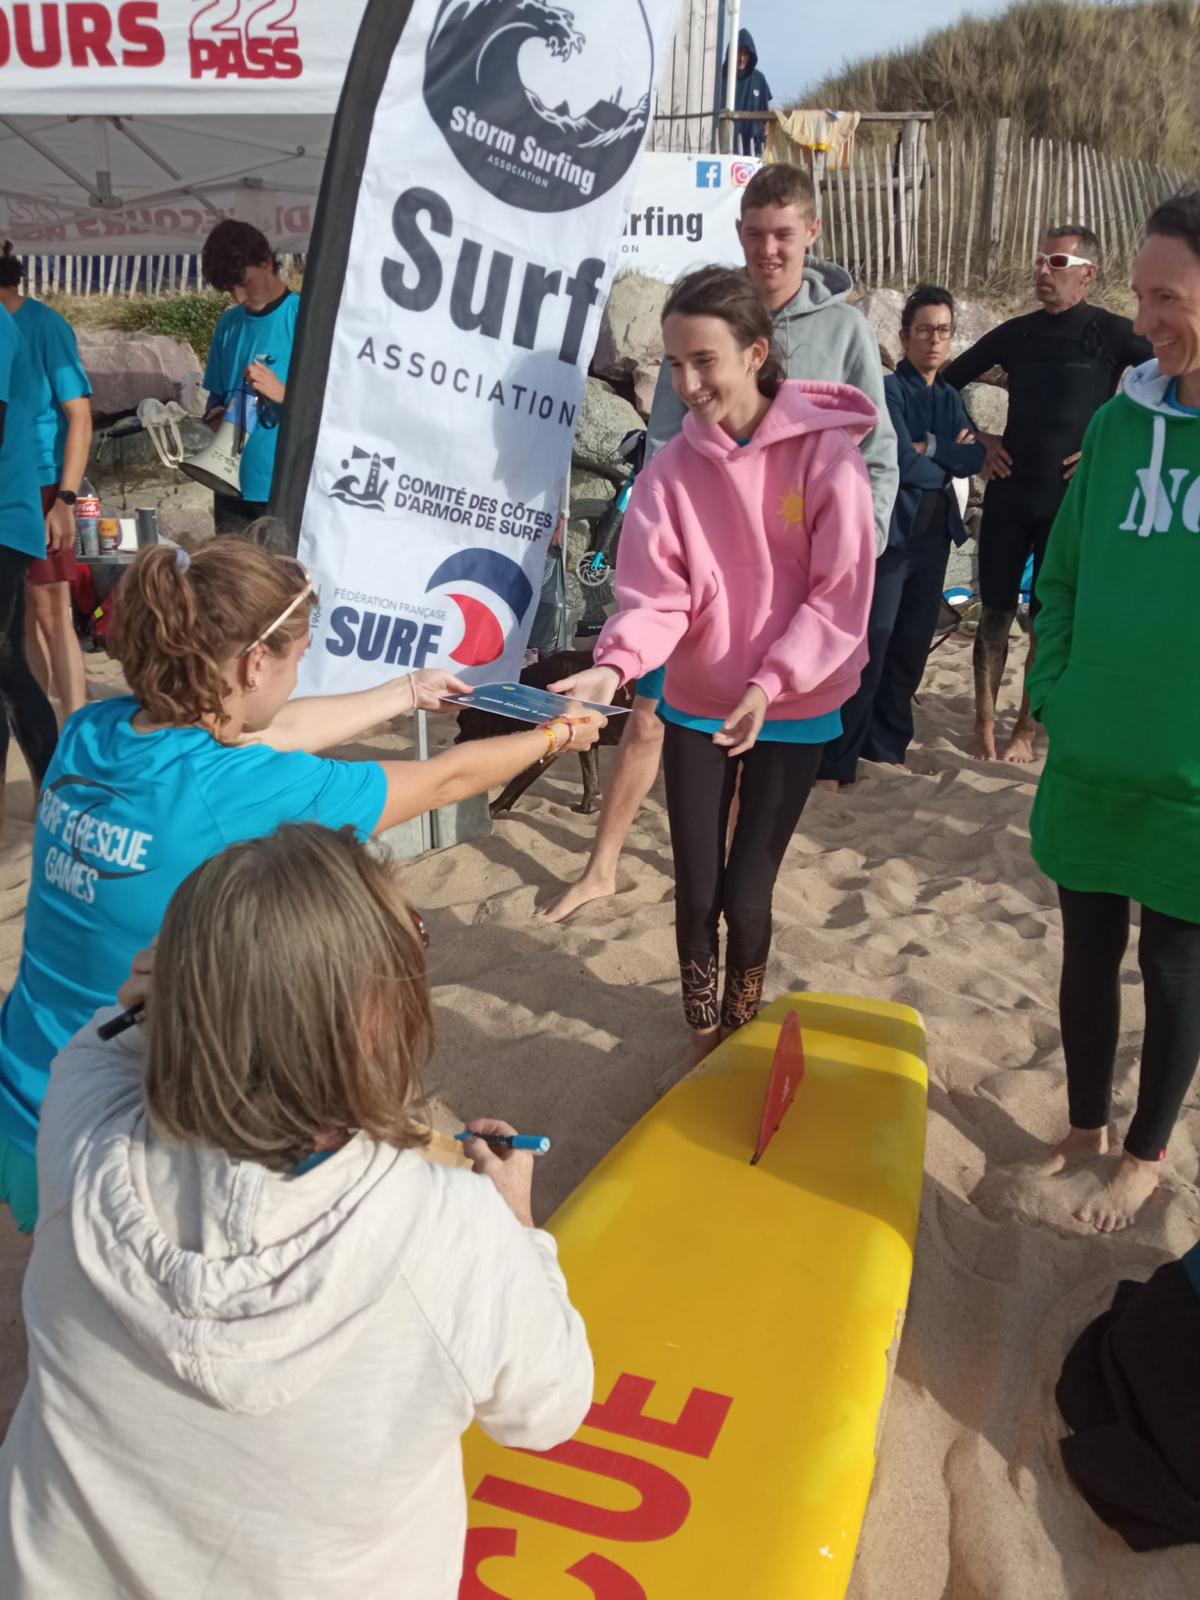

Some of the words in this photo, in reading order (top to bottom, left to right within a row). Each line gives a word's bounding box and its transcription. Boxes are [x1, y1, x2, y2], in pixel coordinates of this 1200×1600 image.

[0, 1, 165, 68] URS
[188, 37, 303, 79] PASS
[450, 105, 516, 155] Storm
[520, 135, 596, 196] Surfing
[487, 154, 549, 188] ASSOCIATION
[622, 206, 703, 242] rfing
[381, 186, 606, 366] Surf
[357, 336, 577, 428] ASSOCIATION
[394, 491, 472, 526] D'ARMOR
[475, 514, 496, 531] DE
[499, 519, 543, 542] SURF
[398, 473, 467, 507] COMITÉ
[469, 494, 498, 515] DES
[501, 501, 553, 529] CÔTES
[334, 587, 397, 611] FÉDÉRATION
[399, 601, 448, 621] FRANÇAISE
[325, 605, 444, 669] SURF
[74, 813, 154, 871] RESCUE
[45, 846, 99, 904] GAMES
